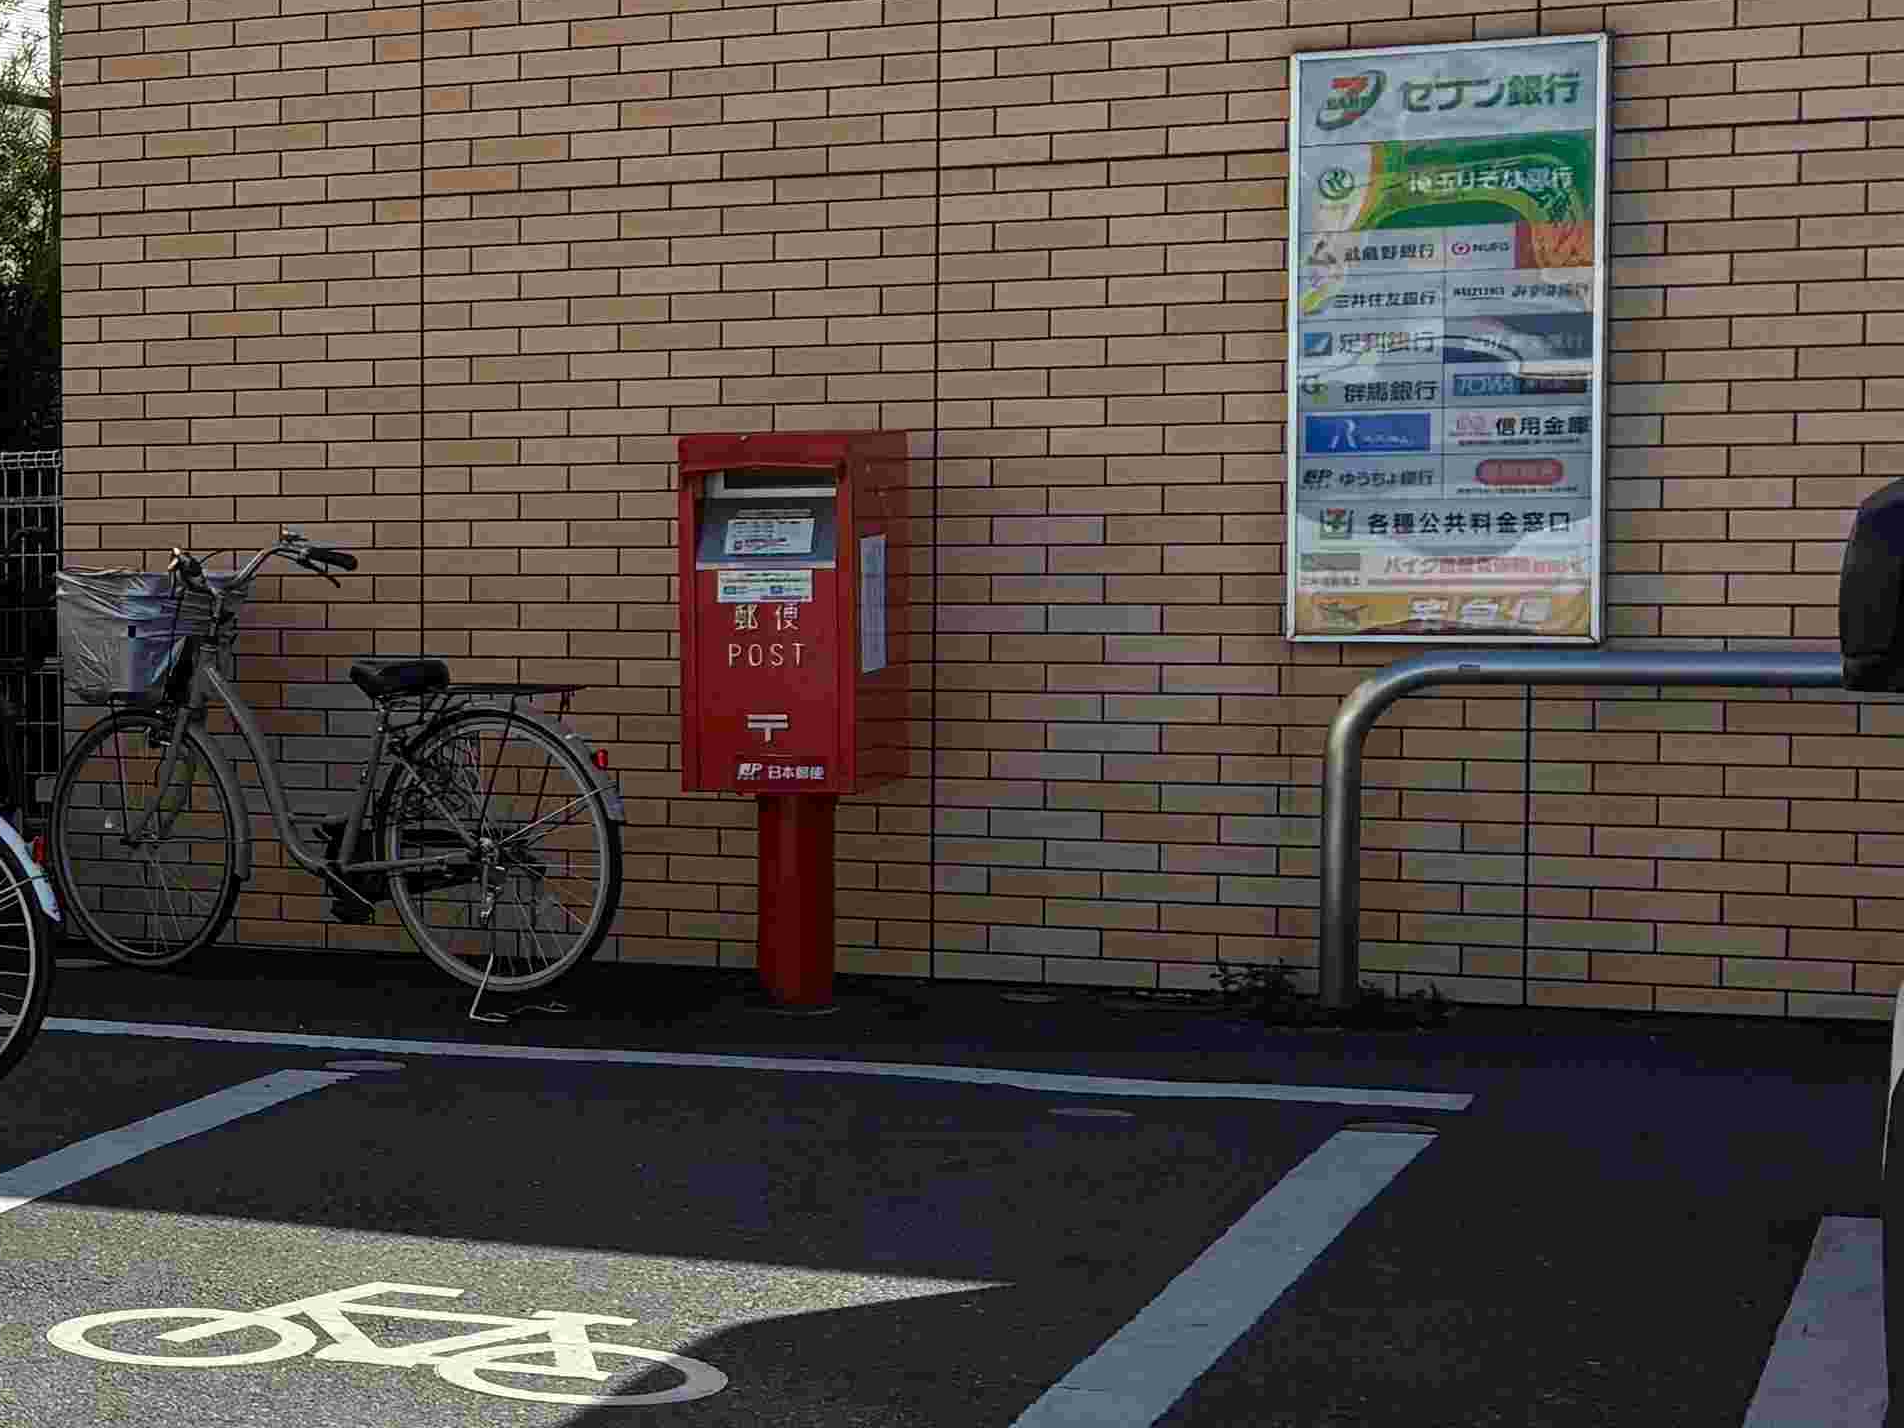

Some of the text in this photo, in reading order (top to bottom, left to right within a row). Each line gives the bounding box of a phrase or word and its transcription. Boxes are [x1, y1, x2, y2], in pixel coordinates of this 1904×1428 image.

[1400, 72, 1583, 112] セブン銀行
[1408, 166, 1576, 195] 埼玉りそな銀行
[1343, 243, 1434, 262] 武蔵野銀行
[1333, 291, 1437, 309] 三井住友銀行
[1344, 379, 1439, 403] 群馬銀行
[1495, 415, 1590, 436] 信用金庫
[1339, 468, 1433, 487] ゆうちょ銀行
[1367, 511, 1570, 534] 各種公共料金窓口
[735, 603, 801, 631] 郵便
[728, 643, 807, 667] POST
[767, 765, 825, 780] 日本郵便
